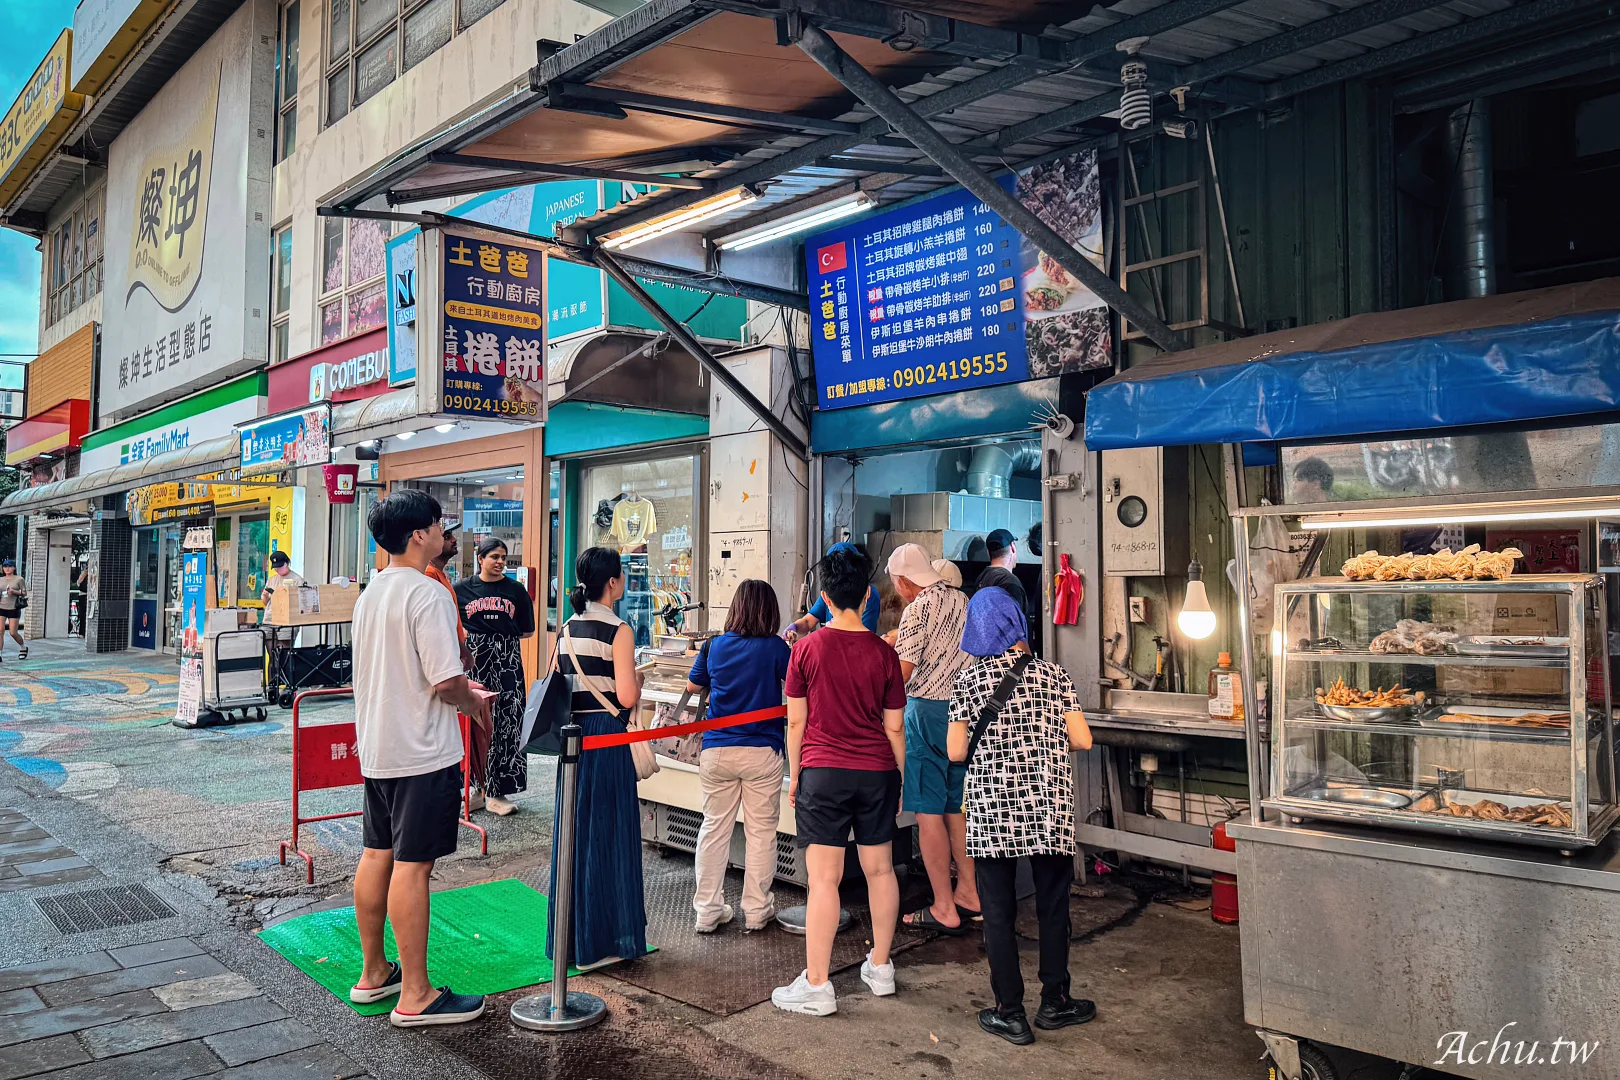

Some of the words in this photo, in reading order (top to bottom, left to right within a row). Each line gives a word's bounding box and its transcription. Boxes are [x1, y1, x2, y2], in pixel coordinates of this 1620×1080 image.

[135, 148, 203, 259] 燦坤
[545, 191, 585, 222] JAPANESE
[972, 203, 991, 216] 140
[974, 222, 992, 236] 160
[449, 240, 530, 279] 土爸爸
[975, 243, 994, 257] 120
[977, 263, 995, 277] 220
[467, 276, 541, 306] 行動廚房
[978, 284, 997, 298] 220
[449, 304, 539, 327] 來自土耳其道地烤肉美食
[548, 301, 587, 323] 潮流服飾
[820, 279, 837, 341] 土爸爸
[836, 275, 852, 363] 行動廚房菜單
[871, 306, 971, 340] 伊斯坦堡羊肉串捲餅
[980, 304, 998, 317] 180
[981, 324, 1000, 337] 180
[118, 314, 213, 390] 燦坤生活型態店
[445, 325, 459, 373] 土耳其
[463, 329, 541, 382] 捲餅
[445, 378, 483, 391] 訂購專線:
[893, 351, 1008, 389] 0902419555
[444, 394, 538, 416] 0902419555
[132, 440, 145, 461] 全家
[146, 426, 190, 459] FamilyMart
